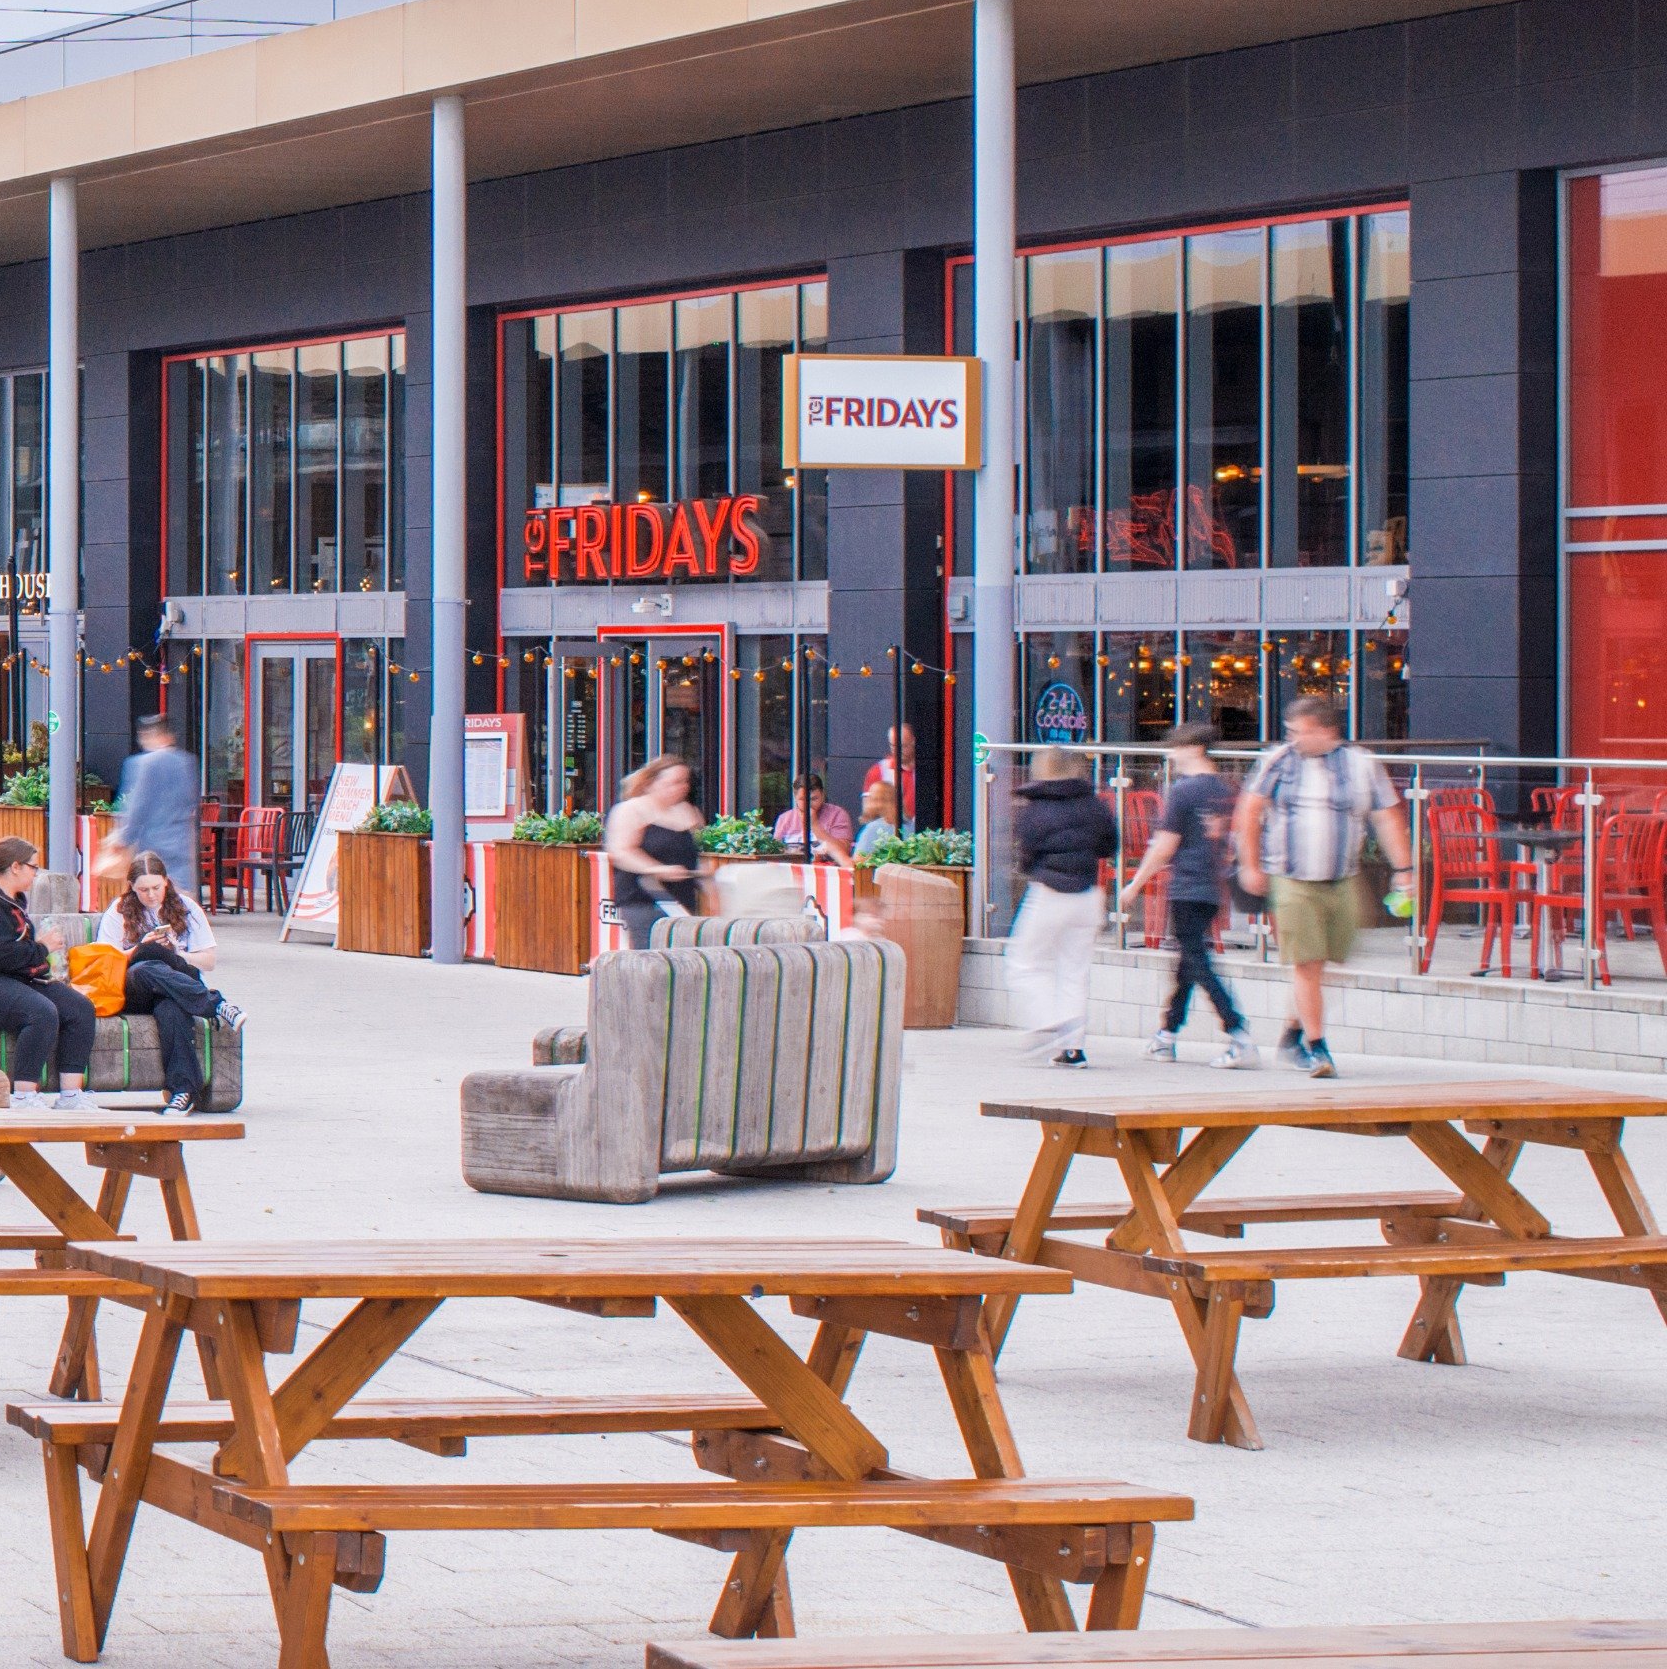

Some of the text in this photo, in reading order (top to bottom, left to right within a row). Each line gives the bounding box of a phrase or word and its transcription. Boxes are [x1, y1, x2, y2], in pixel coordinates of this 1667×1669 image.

[809, 396, 958, 429] TGI FRIDAYS
[524, 494, 760, 582] TGI FRIDAYS
[464, 717, 503, 728] RIDAYS
[338, 775, 360, 787] NEW
[335, 787, 372, 800] SUMMER
[330, 799, 360, 811] LUNCH
[327, 810, 353, 823] MENU
